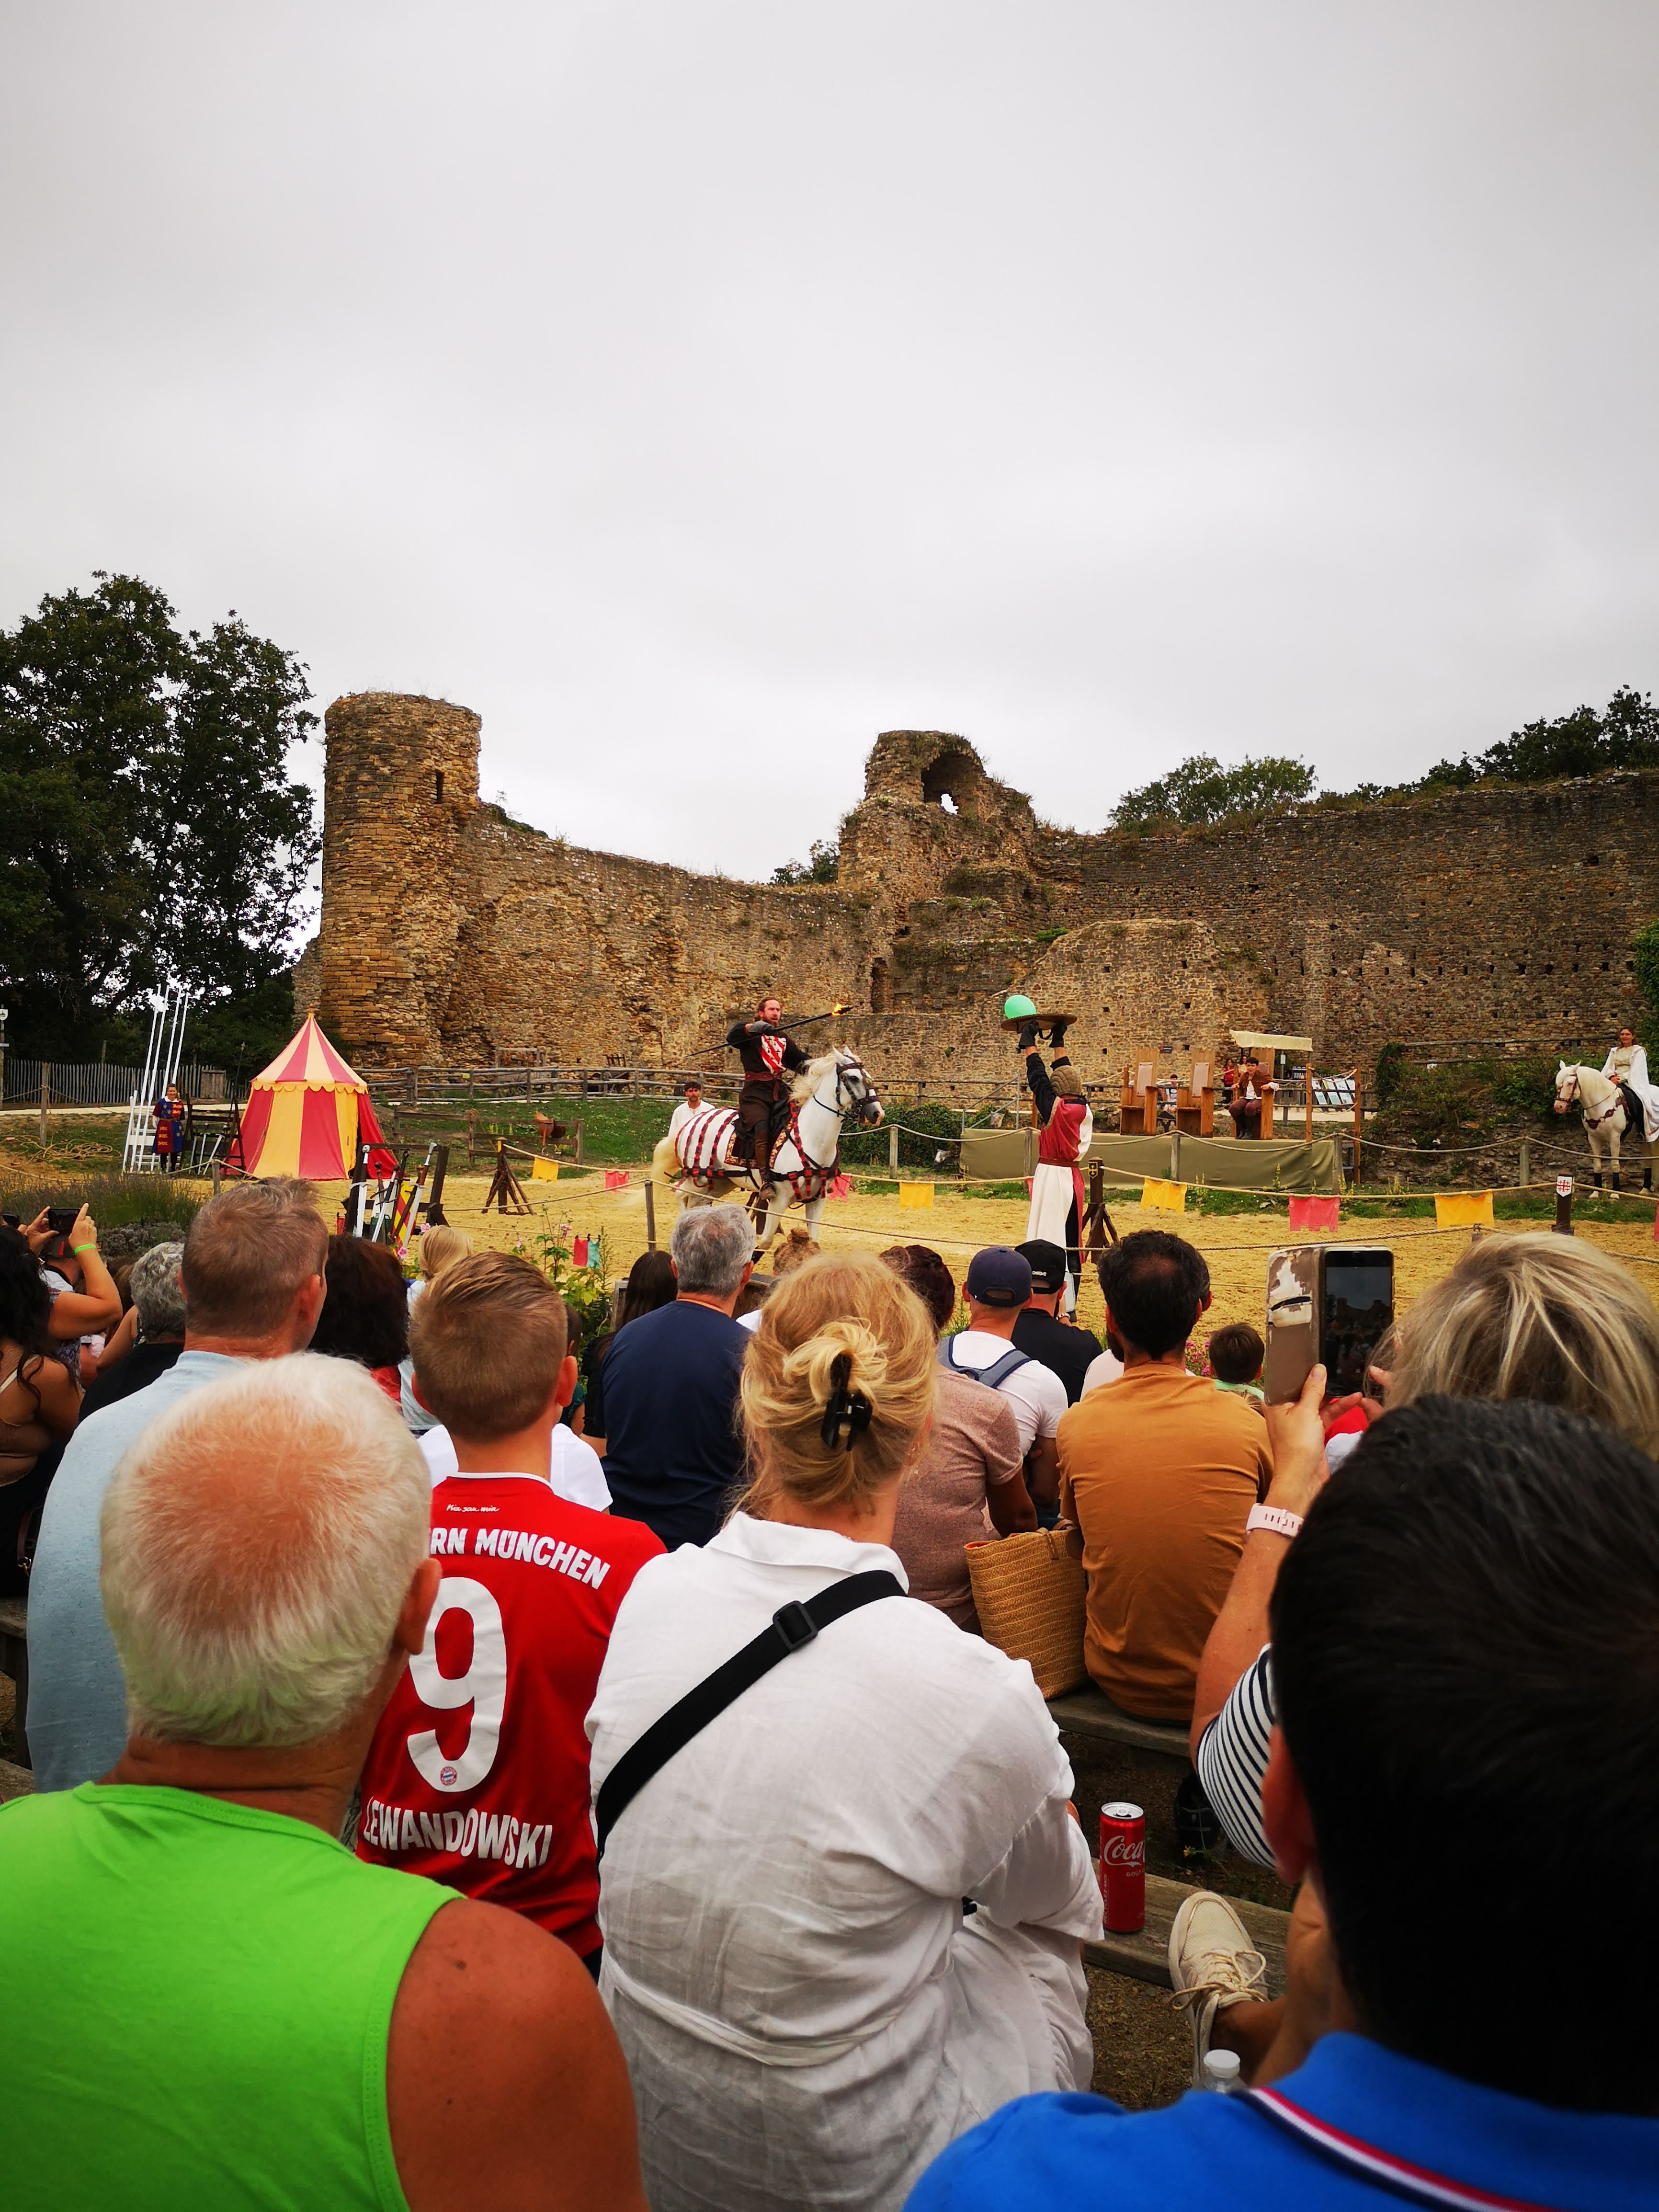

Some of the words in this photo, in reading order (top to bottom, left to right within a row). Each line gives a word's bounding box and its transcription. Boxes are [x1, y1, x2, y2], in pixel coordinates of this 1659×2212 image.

[430, 1527, 468, 1555] RN
[474, 1528, 611, 1590] MÜNCHEN
[407, 1576, 507, 1792] 9
[363, 1796, 553, 1869] LEWANDOWSKI
[1103, 1835, 1145, 1867] Coca
